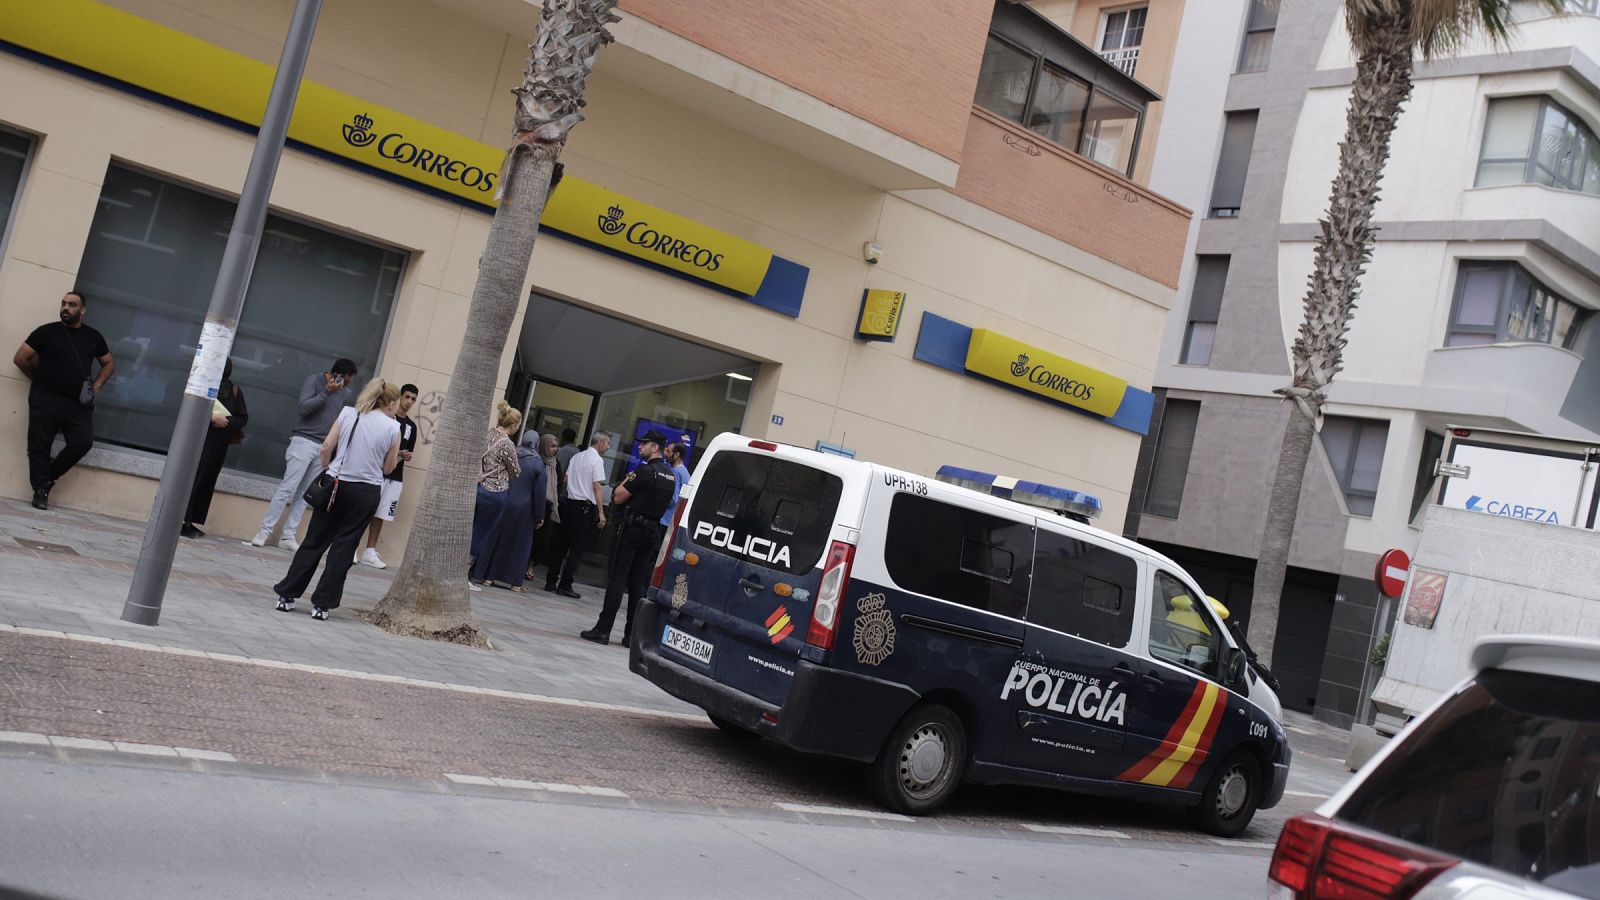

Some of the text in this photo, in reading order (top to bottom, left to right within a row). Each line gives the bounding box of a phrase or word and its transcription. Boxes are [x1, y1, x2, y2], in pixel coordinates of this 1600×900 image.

[377, 133, 498, 192] CORREOS
[626, 221, 724, 272] CORREOS
[884, 291, 902, 334] CORREOS
[1028, 365, 1095, 401] CORREOS
[884, 471, 928, 496] UPR-138
[1487, 501, 1559, 524] CABEZA
[693, 520, 791, 568] POLICIA
[666, 629, 712, 660] CNP3618AM
[748, 655, 795, 677] www.policia.es
[1014, 660, 1101, 687] CUERPO NACIONAL DE
[1000, 666, 1127, 726] POLICÍA
[1031, 737, 1096, 754] www.policia.es
[1253, 723, 1269, 739] 091
